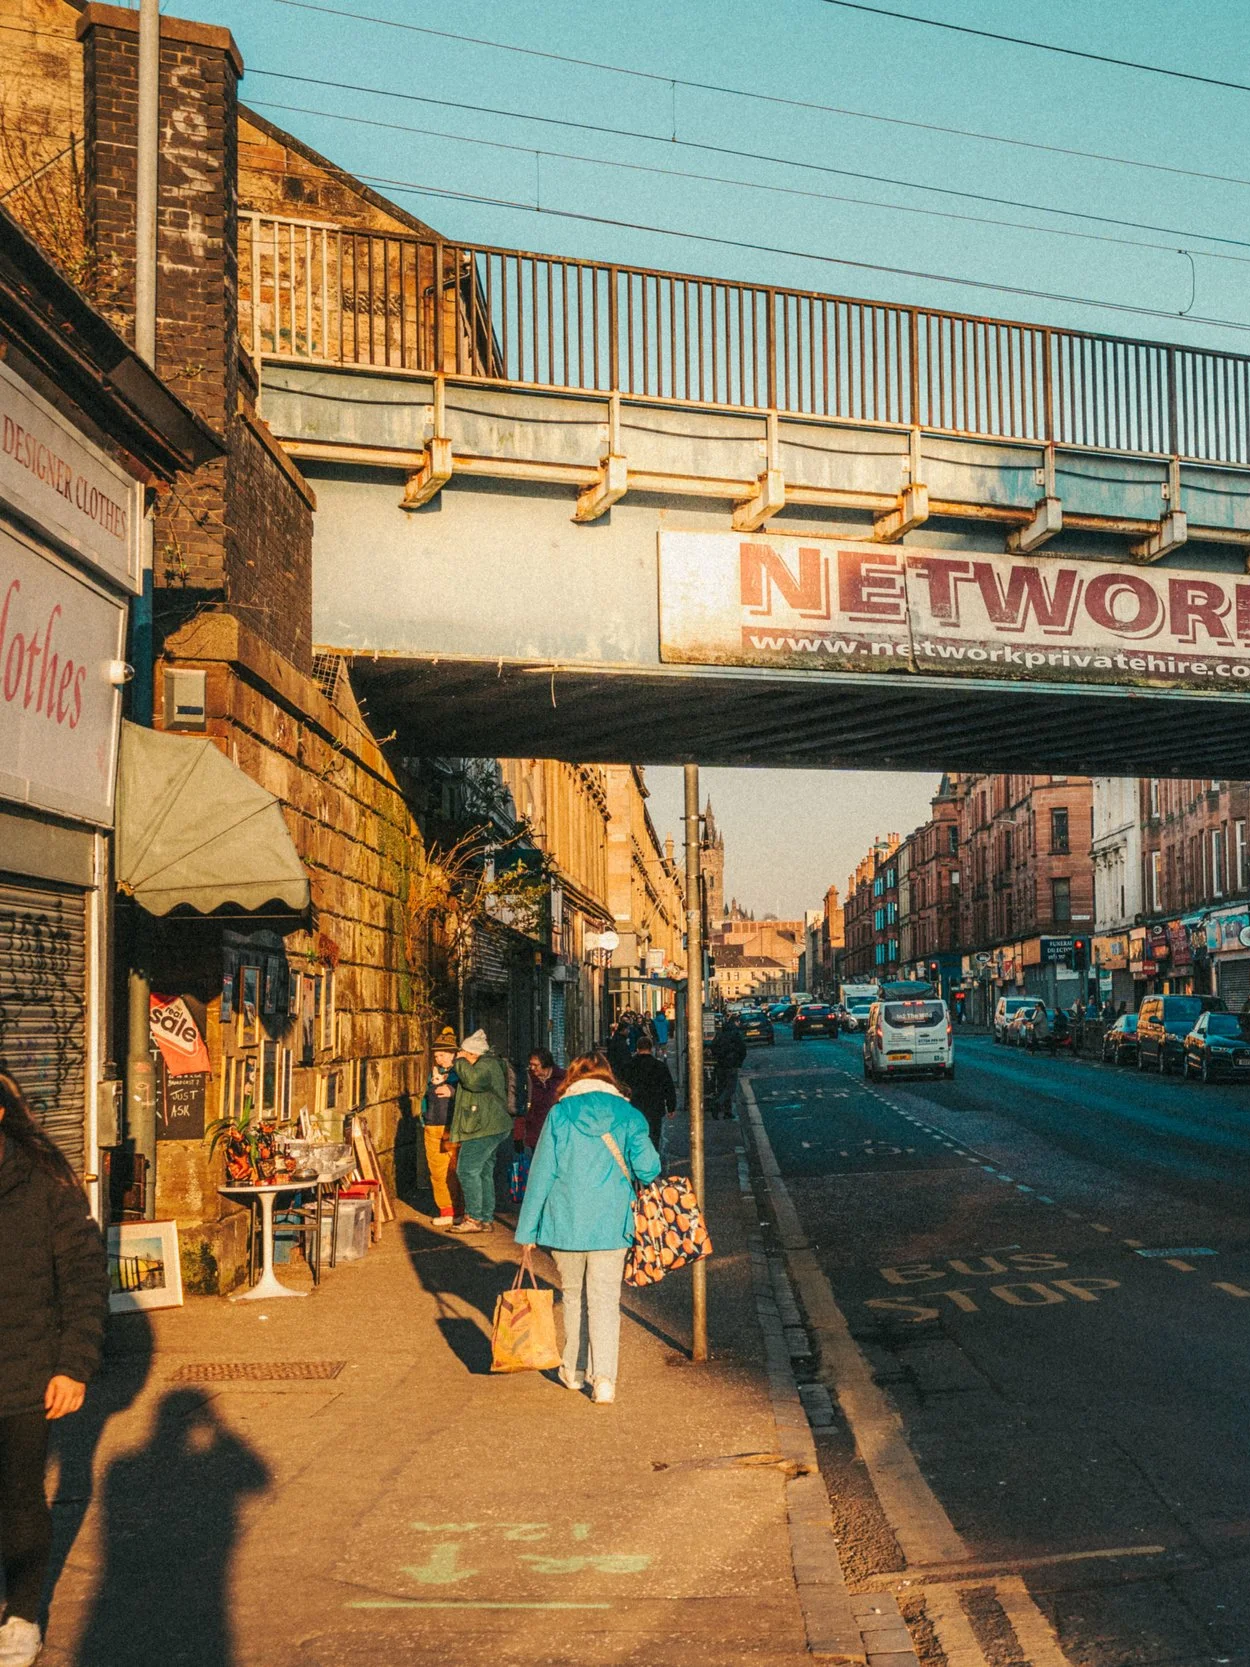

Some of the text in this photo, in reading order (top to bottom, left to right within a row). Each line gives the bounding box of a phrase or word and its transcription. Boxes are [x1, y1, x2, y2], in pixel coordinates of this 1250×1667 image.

[2, 414, 128, 541] DESIGNER CLOTHES
[150, 1008, 197, 1043] sale
[165, 1006, 184, 1019] real
[169, 1088, 199, 1101] JUST
[170, 1104, 190, 1118] ASK
[880, 1253, 1068, 1286] BUS
[866, 1278, 1121, 1323] STOP
